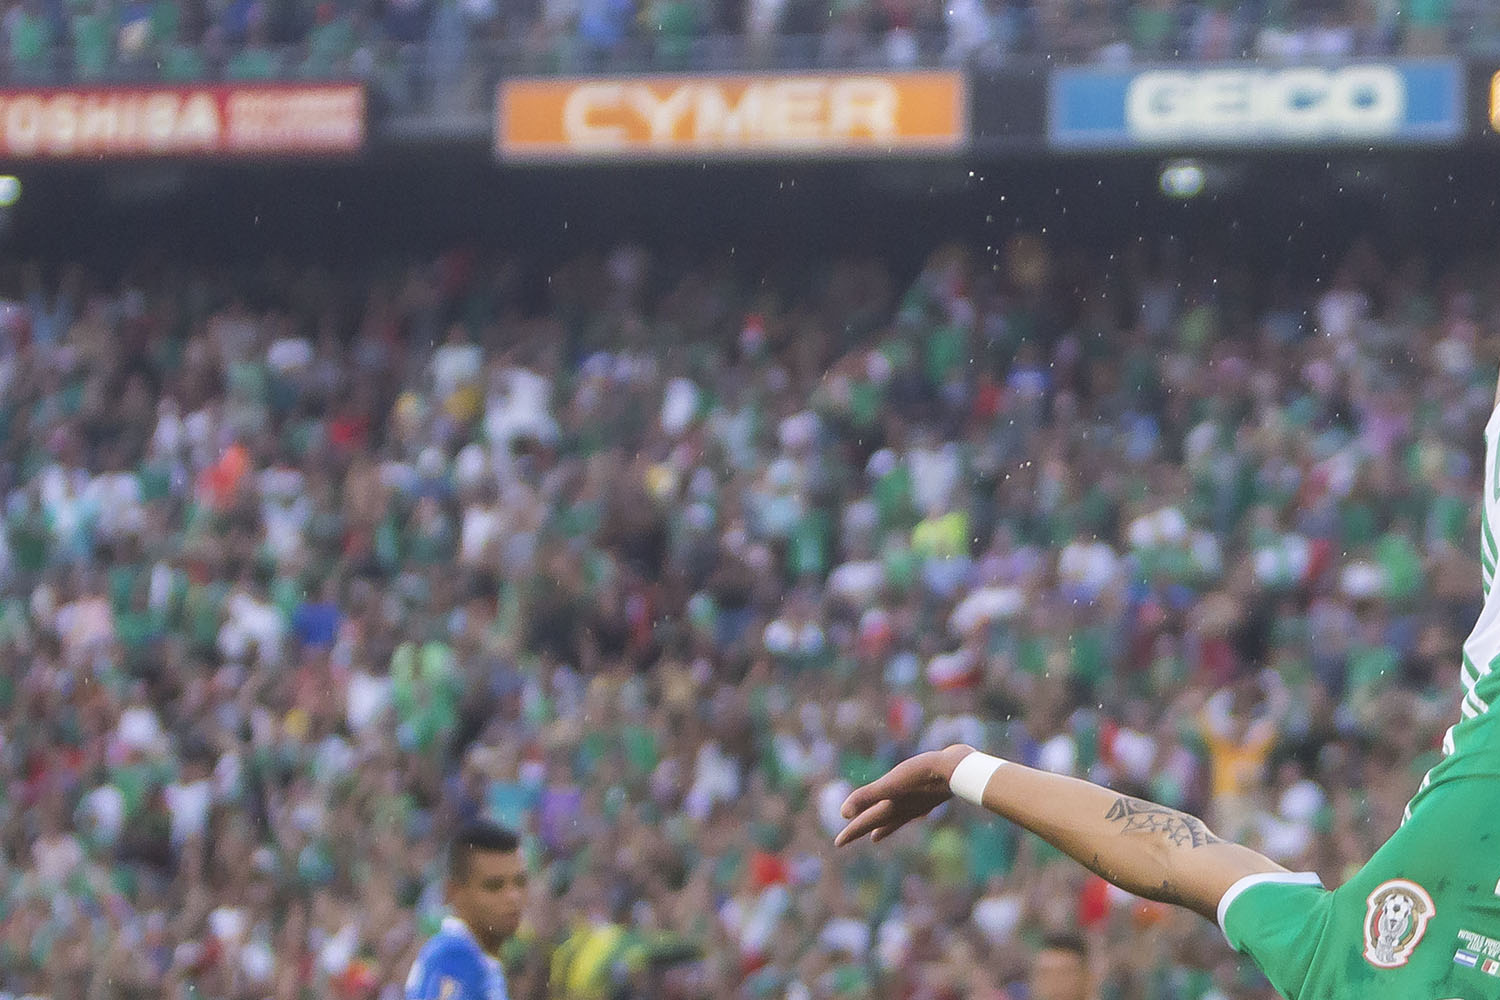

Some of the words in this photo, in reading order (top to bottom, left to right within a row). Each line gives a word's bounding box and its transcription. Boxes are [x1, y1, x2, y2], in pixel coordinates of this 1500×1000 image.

[0, 92, 220, 152] OSHIBA
[562, 80, 900, 152] CYMER
[1127, 68, 1405, 138] GEICO
